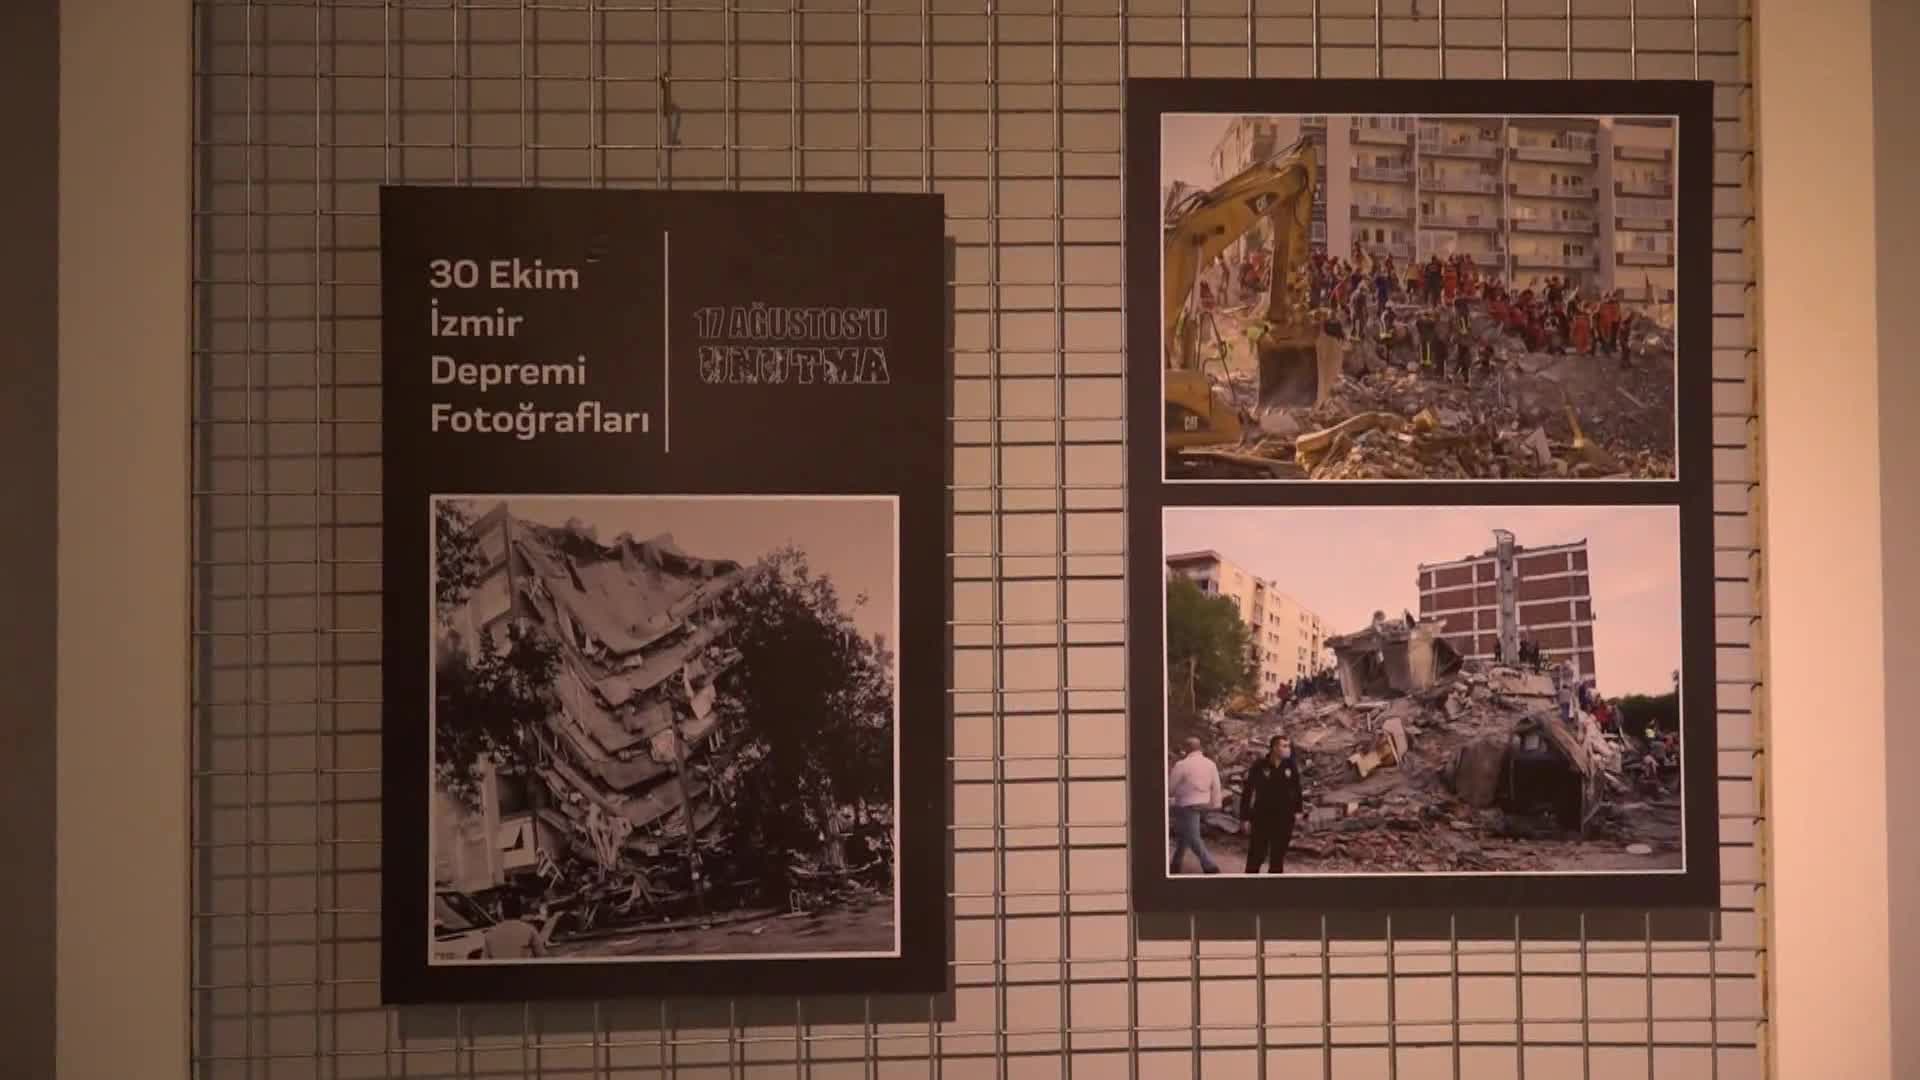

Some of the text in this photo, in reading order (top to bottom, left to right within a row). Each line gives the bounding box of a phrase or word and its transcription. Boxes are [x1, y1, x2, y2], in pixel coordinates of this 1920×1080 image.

[430, 258, 579, 289] 30 Ekim
[431, 298, 524, 336] İzmir
[694, 301, 888, 340] 17 AĞUSTOS'U
[431, 355, 586, 392] Depremi
[699, 346, 890, 384] UNUTMA
[431, 401, 649, 440] Fotoğrafları
